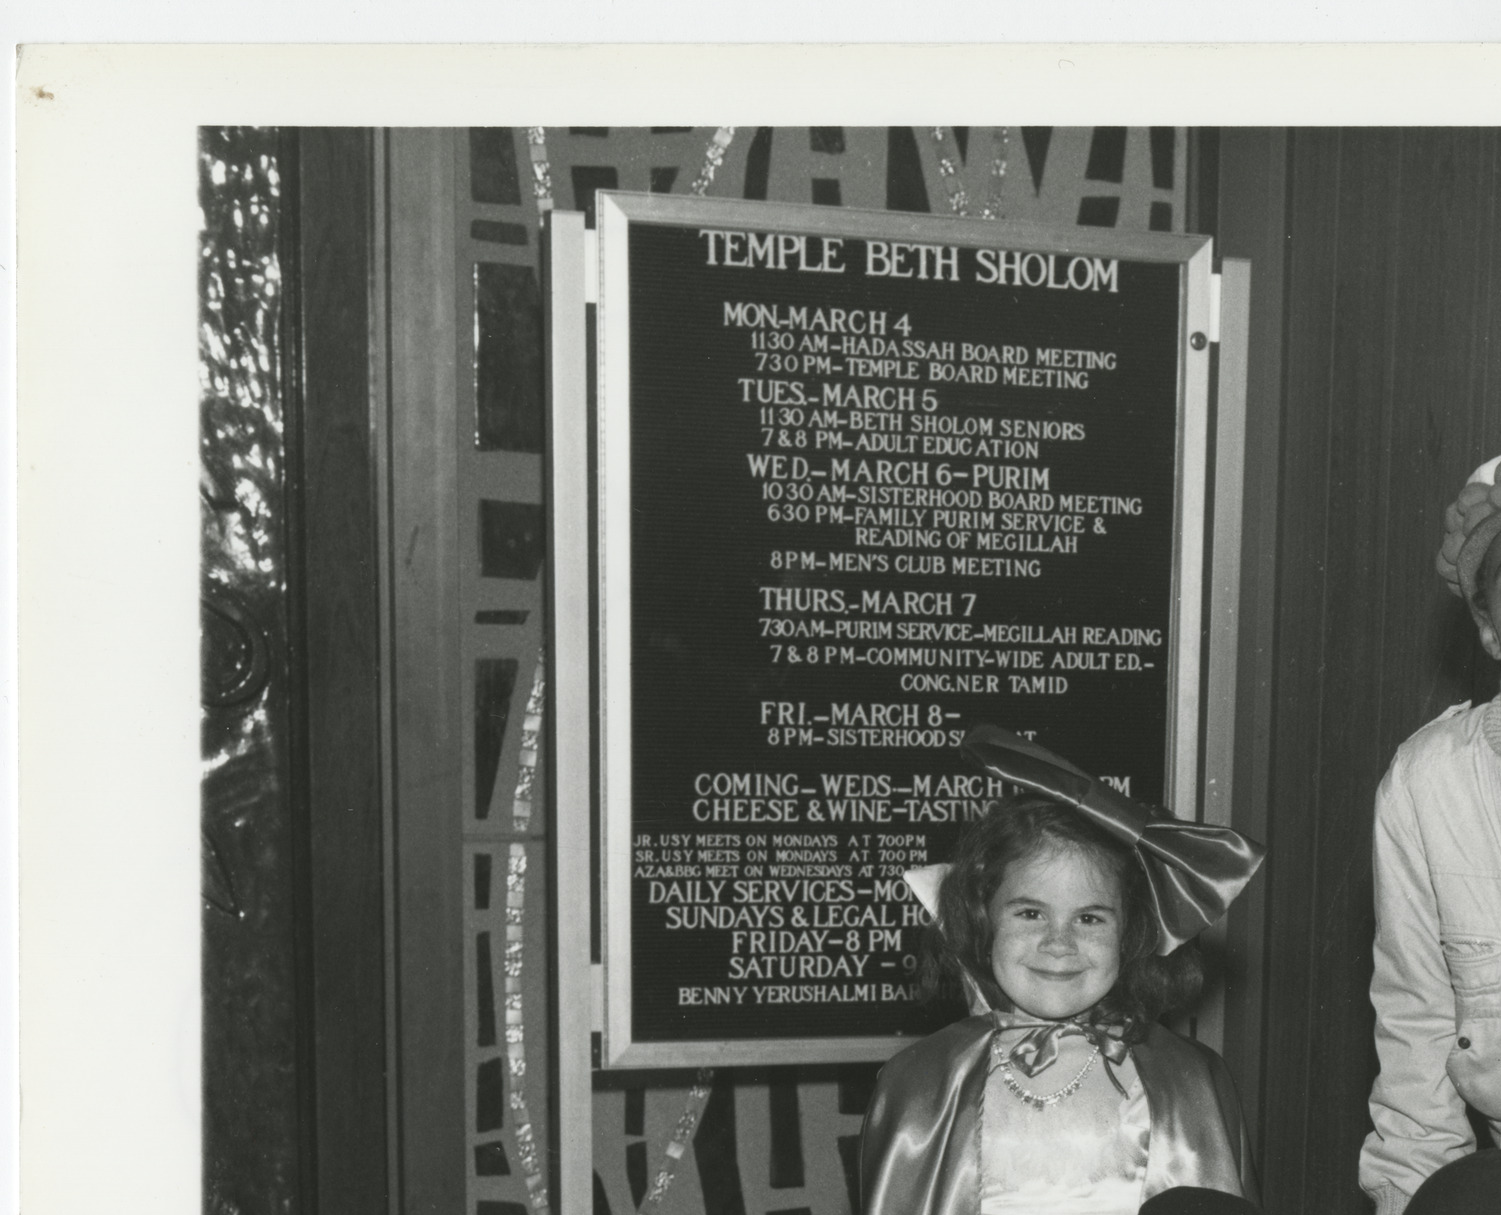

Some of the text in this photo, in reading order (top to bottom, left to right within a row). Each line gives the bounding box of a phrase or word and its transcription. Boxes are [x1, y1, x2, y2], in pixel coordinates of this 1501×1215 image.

[699, 229, 1119, 293] TEMPLE BETH SHOLOM
[893, 313, 912, 337] 4
[751, 330, 795, 350] 1130
[961, 343, 1029, 365] BOARD
[1036, 348, 1117, 371] MEETING
[754, 352, 799, 372] 730
[929, 362, 998, 384] BOARD
[1003, 366, 1089, 389] MEETING
[921, 389, 938, 412] 5
[760, 407, 804, 426] 1130
[910, 415, 993, 436] SHOLOM
[1000, 419, 1086, 441] SENIORS
[923, 436, 1039, 459] EDUCATION
[762, 482, 813, 501] 1030
[988, 490, 1054, 511] BOARD
[1059, 494, 1143, 515] MEETING
[767, 504, 809, 522] 630
[933, 510, 994, 530] PURIM
[1001, 513, 1085, 533] SERVICE
[1092, 516, 1107, 534] &
[855, 527, 1078, 553] READING OF MEGILLAH
[895, 555, 945, 574] CLUB
[952, 556, 1041, 577] MEETING
[961, 593, 976, 616] 7
[1082, 627, 1162, 646] READING
[1051, 652, 1110, 670] ADULT
[1008, 675, 1068, 694] TAMID
[692, 799, 799, 822] CHEESE
[696, 835, 741, 847] MEETS
[746, 835, 767, 847] ON
[773, 835, 838, 847] MONDAYS
[848, 835, 871, 847] AT
[696, 850, 740, 862] MEETS
[746, 850, 767, 862] ON
[776, 850, 837, 862] MONDAYS
[849, 850, 870, 862] AT
[634, 865, 701, 878] AZA&BBG
[705, 865, 740, 877] MEET
[745, 865, 763, 877] ON
[769, 865, 852, 877] WEDNESDAYS
[858, 865, 874, 877] AT
[649, 880, 726, 903] DAILY
[666, 906, 784, 929] SUNDAYS
[791, 906, 810, 929] &
[813, 905, 896, 927] LEGAL
[868, 930, 902, 952] PM
[728, 954, 870, 980] SATURDAY
[678, 986, 748, 1006] BENNY
[752, 984, 876, 1004] YERUSHALMI
